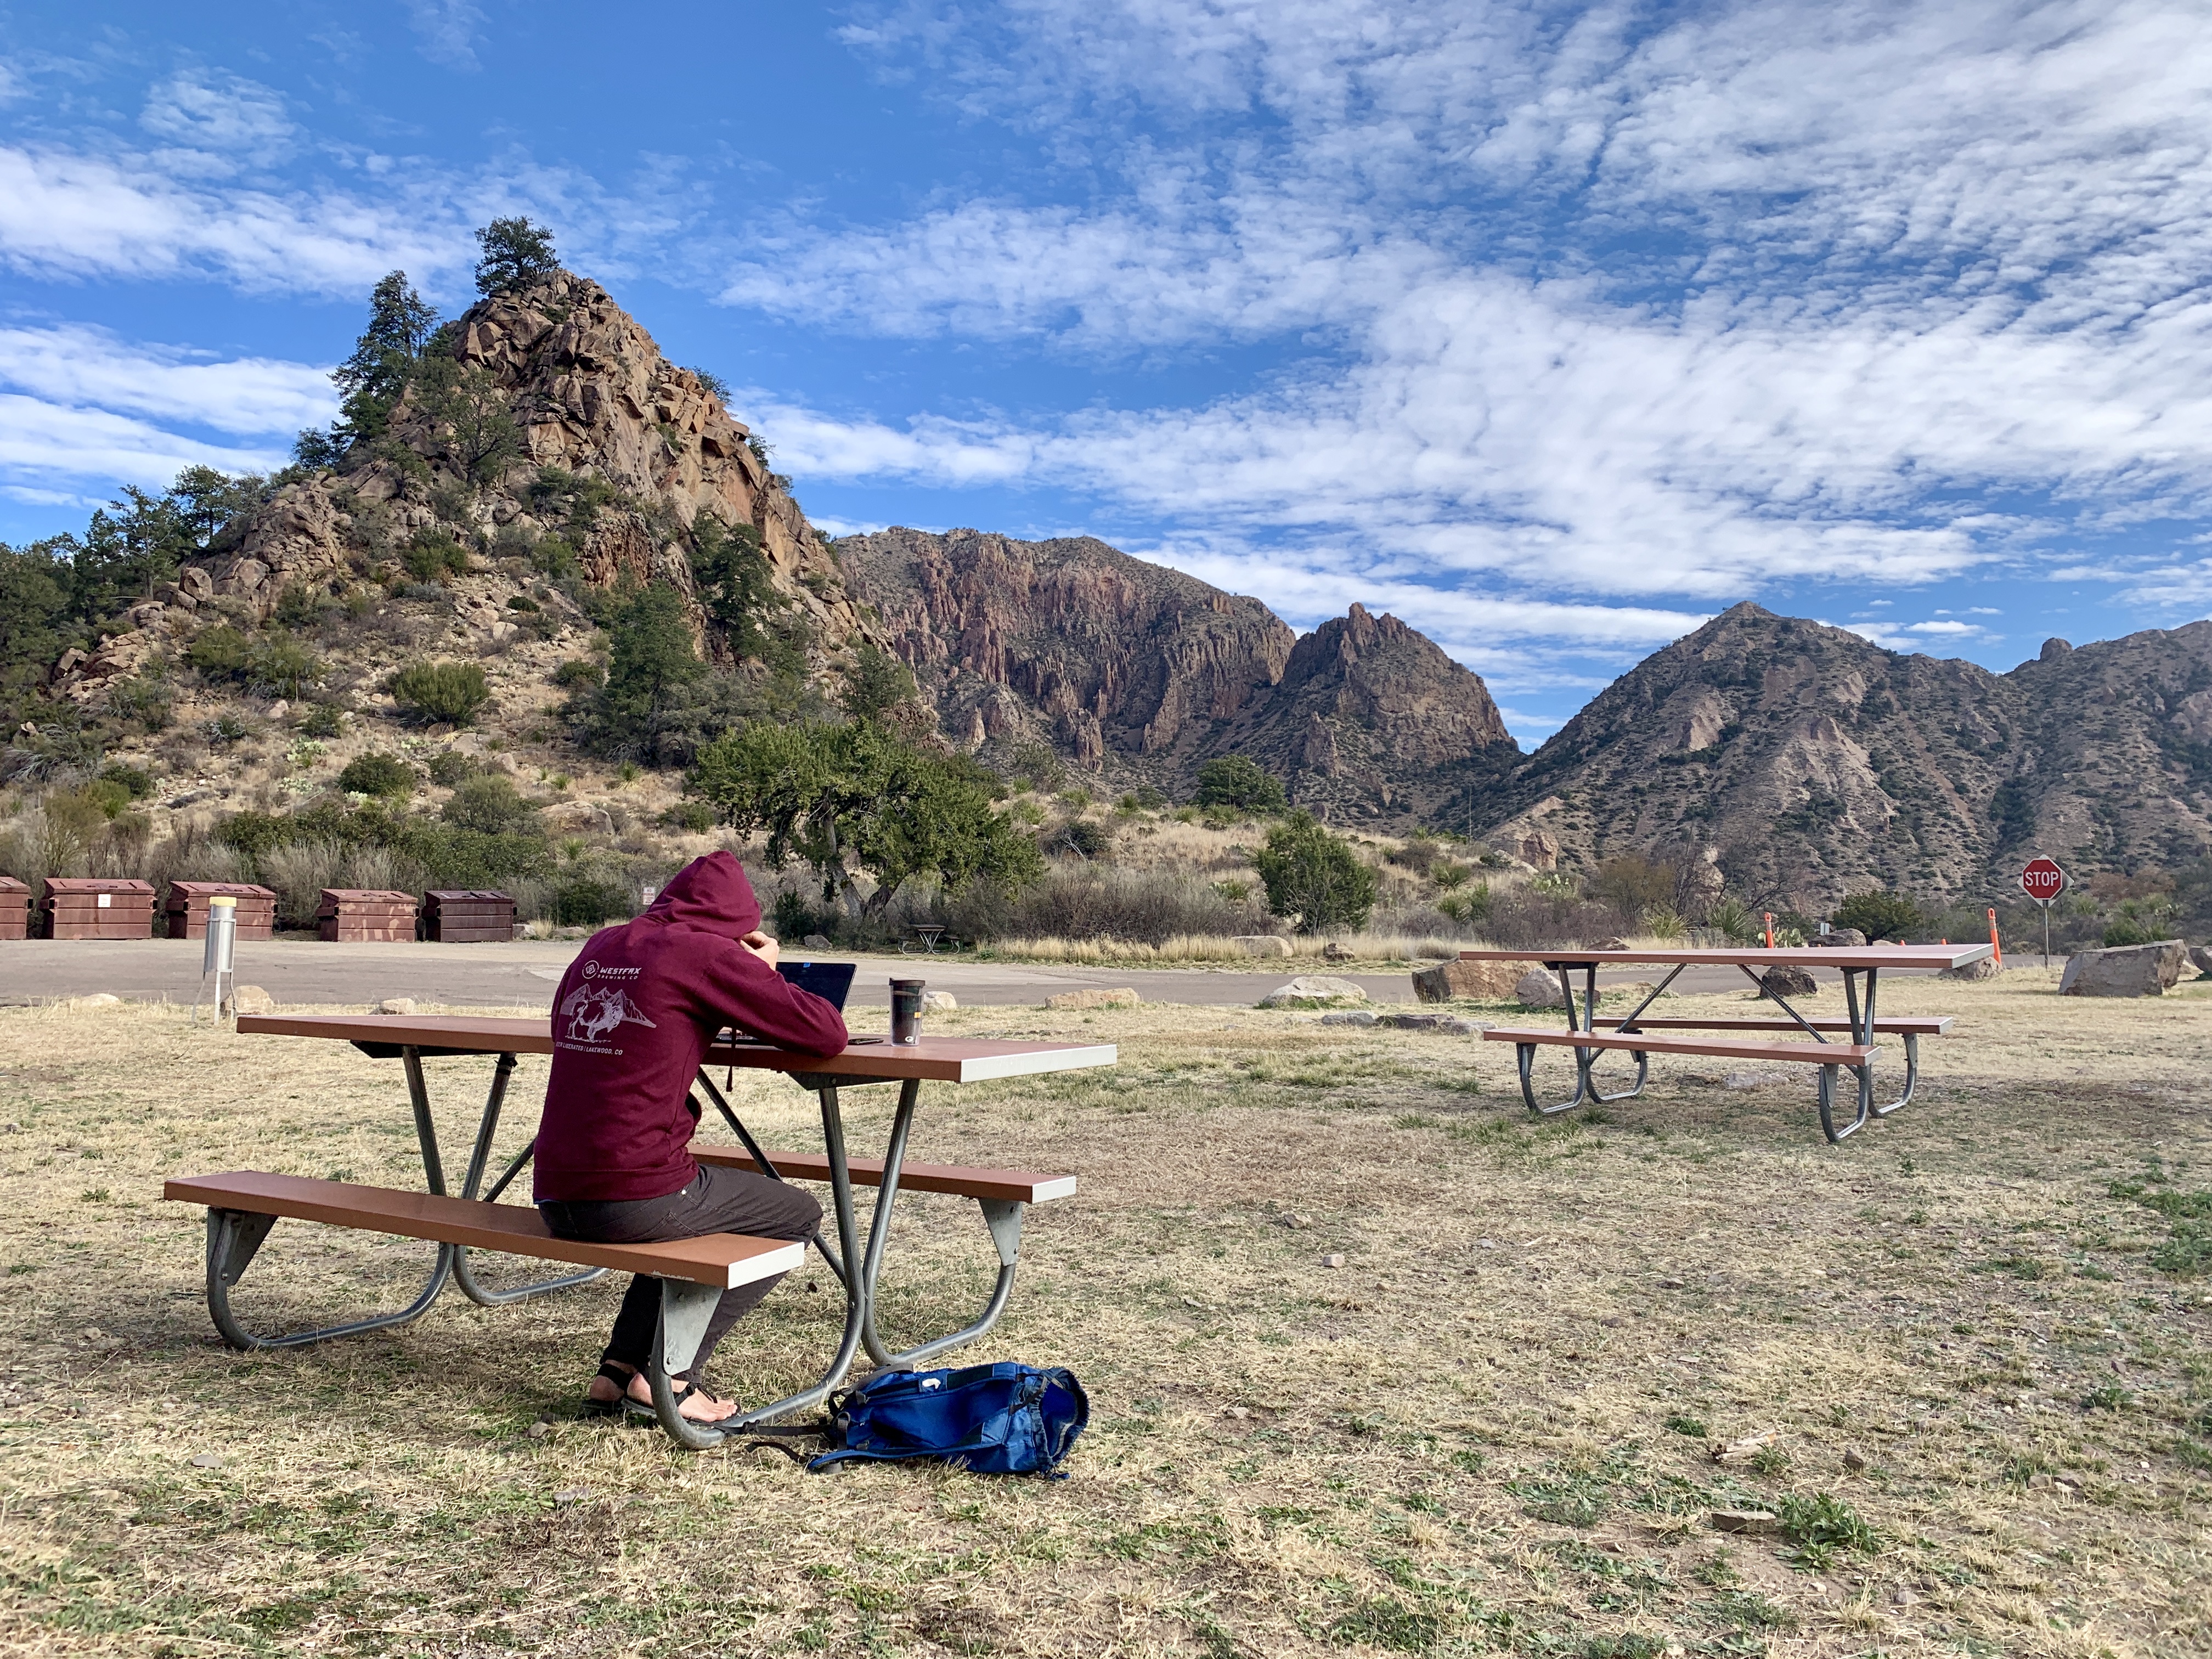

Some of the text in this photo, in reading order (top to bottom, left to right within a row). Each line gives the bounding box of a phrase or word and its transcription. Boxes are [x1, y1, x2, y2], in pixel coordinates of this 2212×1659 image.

[2025, 871, 2059, 887] STOP
[562, 1042, 583, 1051] LIBERATED
[586, 1047, 613, 1055] LAKEWOOD,
